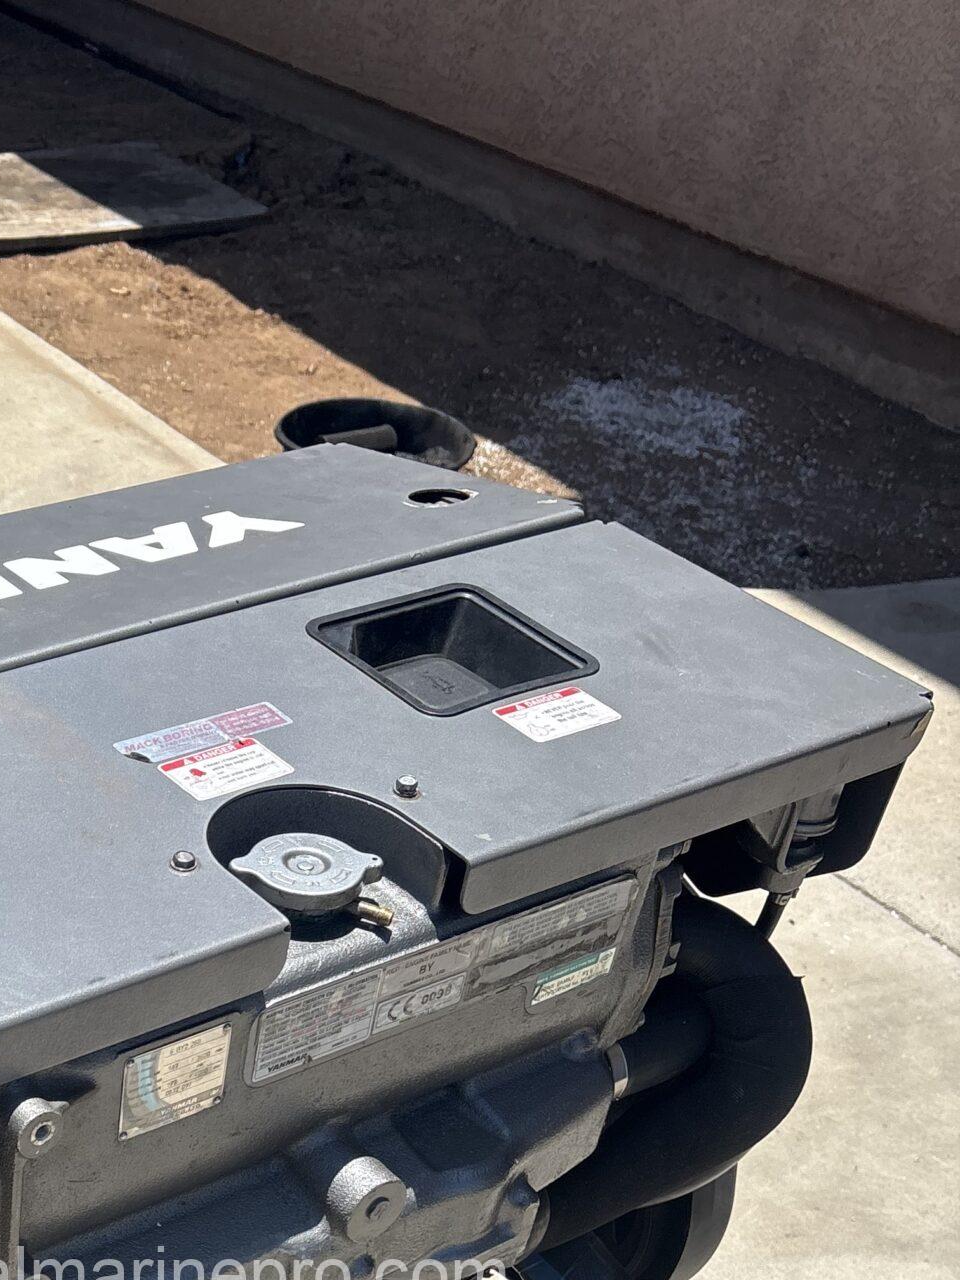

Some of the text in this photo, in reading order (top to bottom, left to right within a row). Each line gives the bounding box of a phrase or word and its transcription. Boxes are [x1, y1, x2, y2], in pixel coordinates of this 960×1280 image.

[523, 692, 564, 707] DANGER
[162, 721, 214, 743] BORING
[192, 744, 238, 761] DANGER
[418, 960, 435, 975] BY
[159, 1096, 197, 1116] YANMAR
